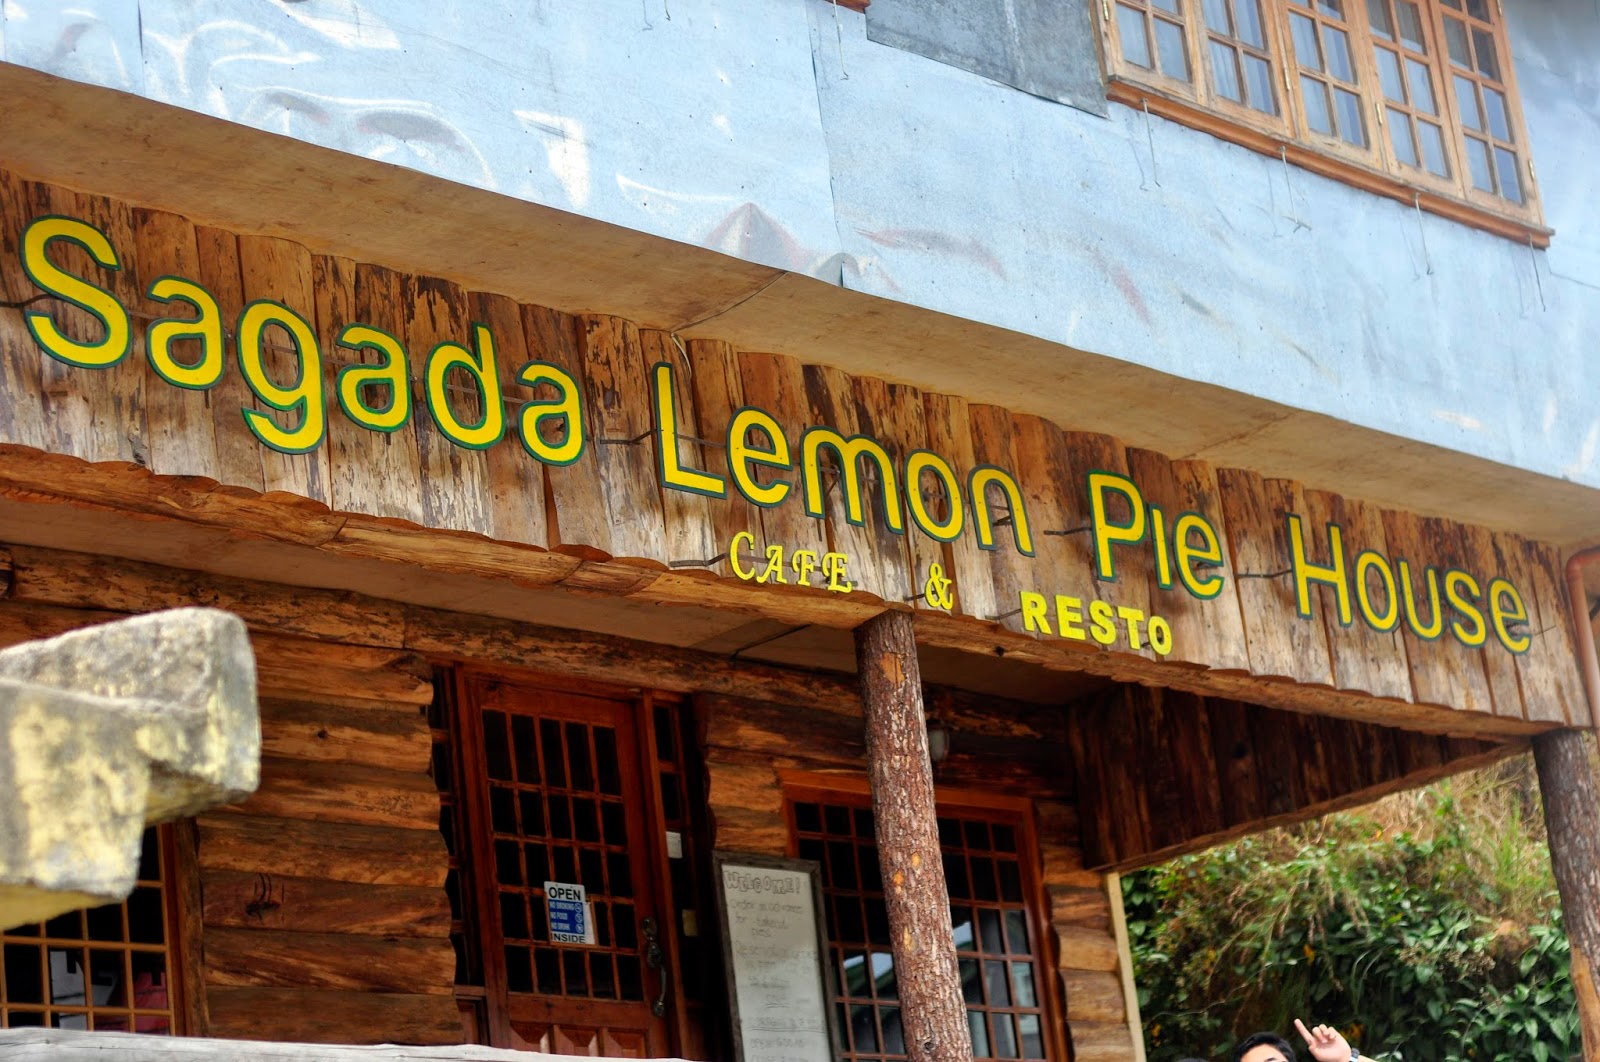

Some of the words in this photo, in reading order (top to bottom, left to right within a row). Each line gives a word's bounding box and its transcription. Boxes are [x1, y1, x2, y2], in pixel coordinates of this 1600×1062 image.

[20, 214, 586, 467] Sagada
[651, 362, 1036, 557] Lemon
[1286, 512, 1532, 655] House
[729, 532, 853, 593] CAFE
[925, 563, 954, 610] &
[1020, 591, 1173, 656] RESTO
[548, 887, 581, 901] OPEN
[723, 871, 800, 894] WELCOME!
[551, 932, 586, 944] INSIDE
